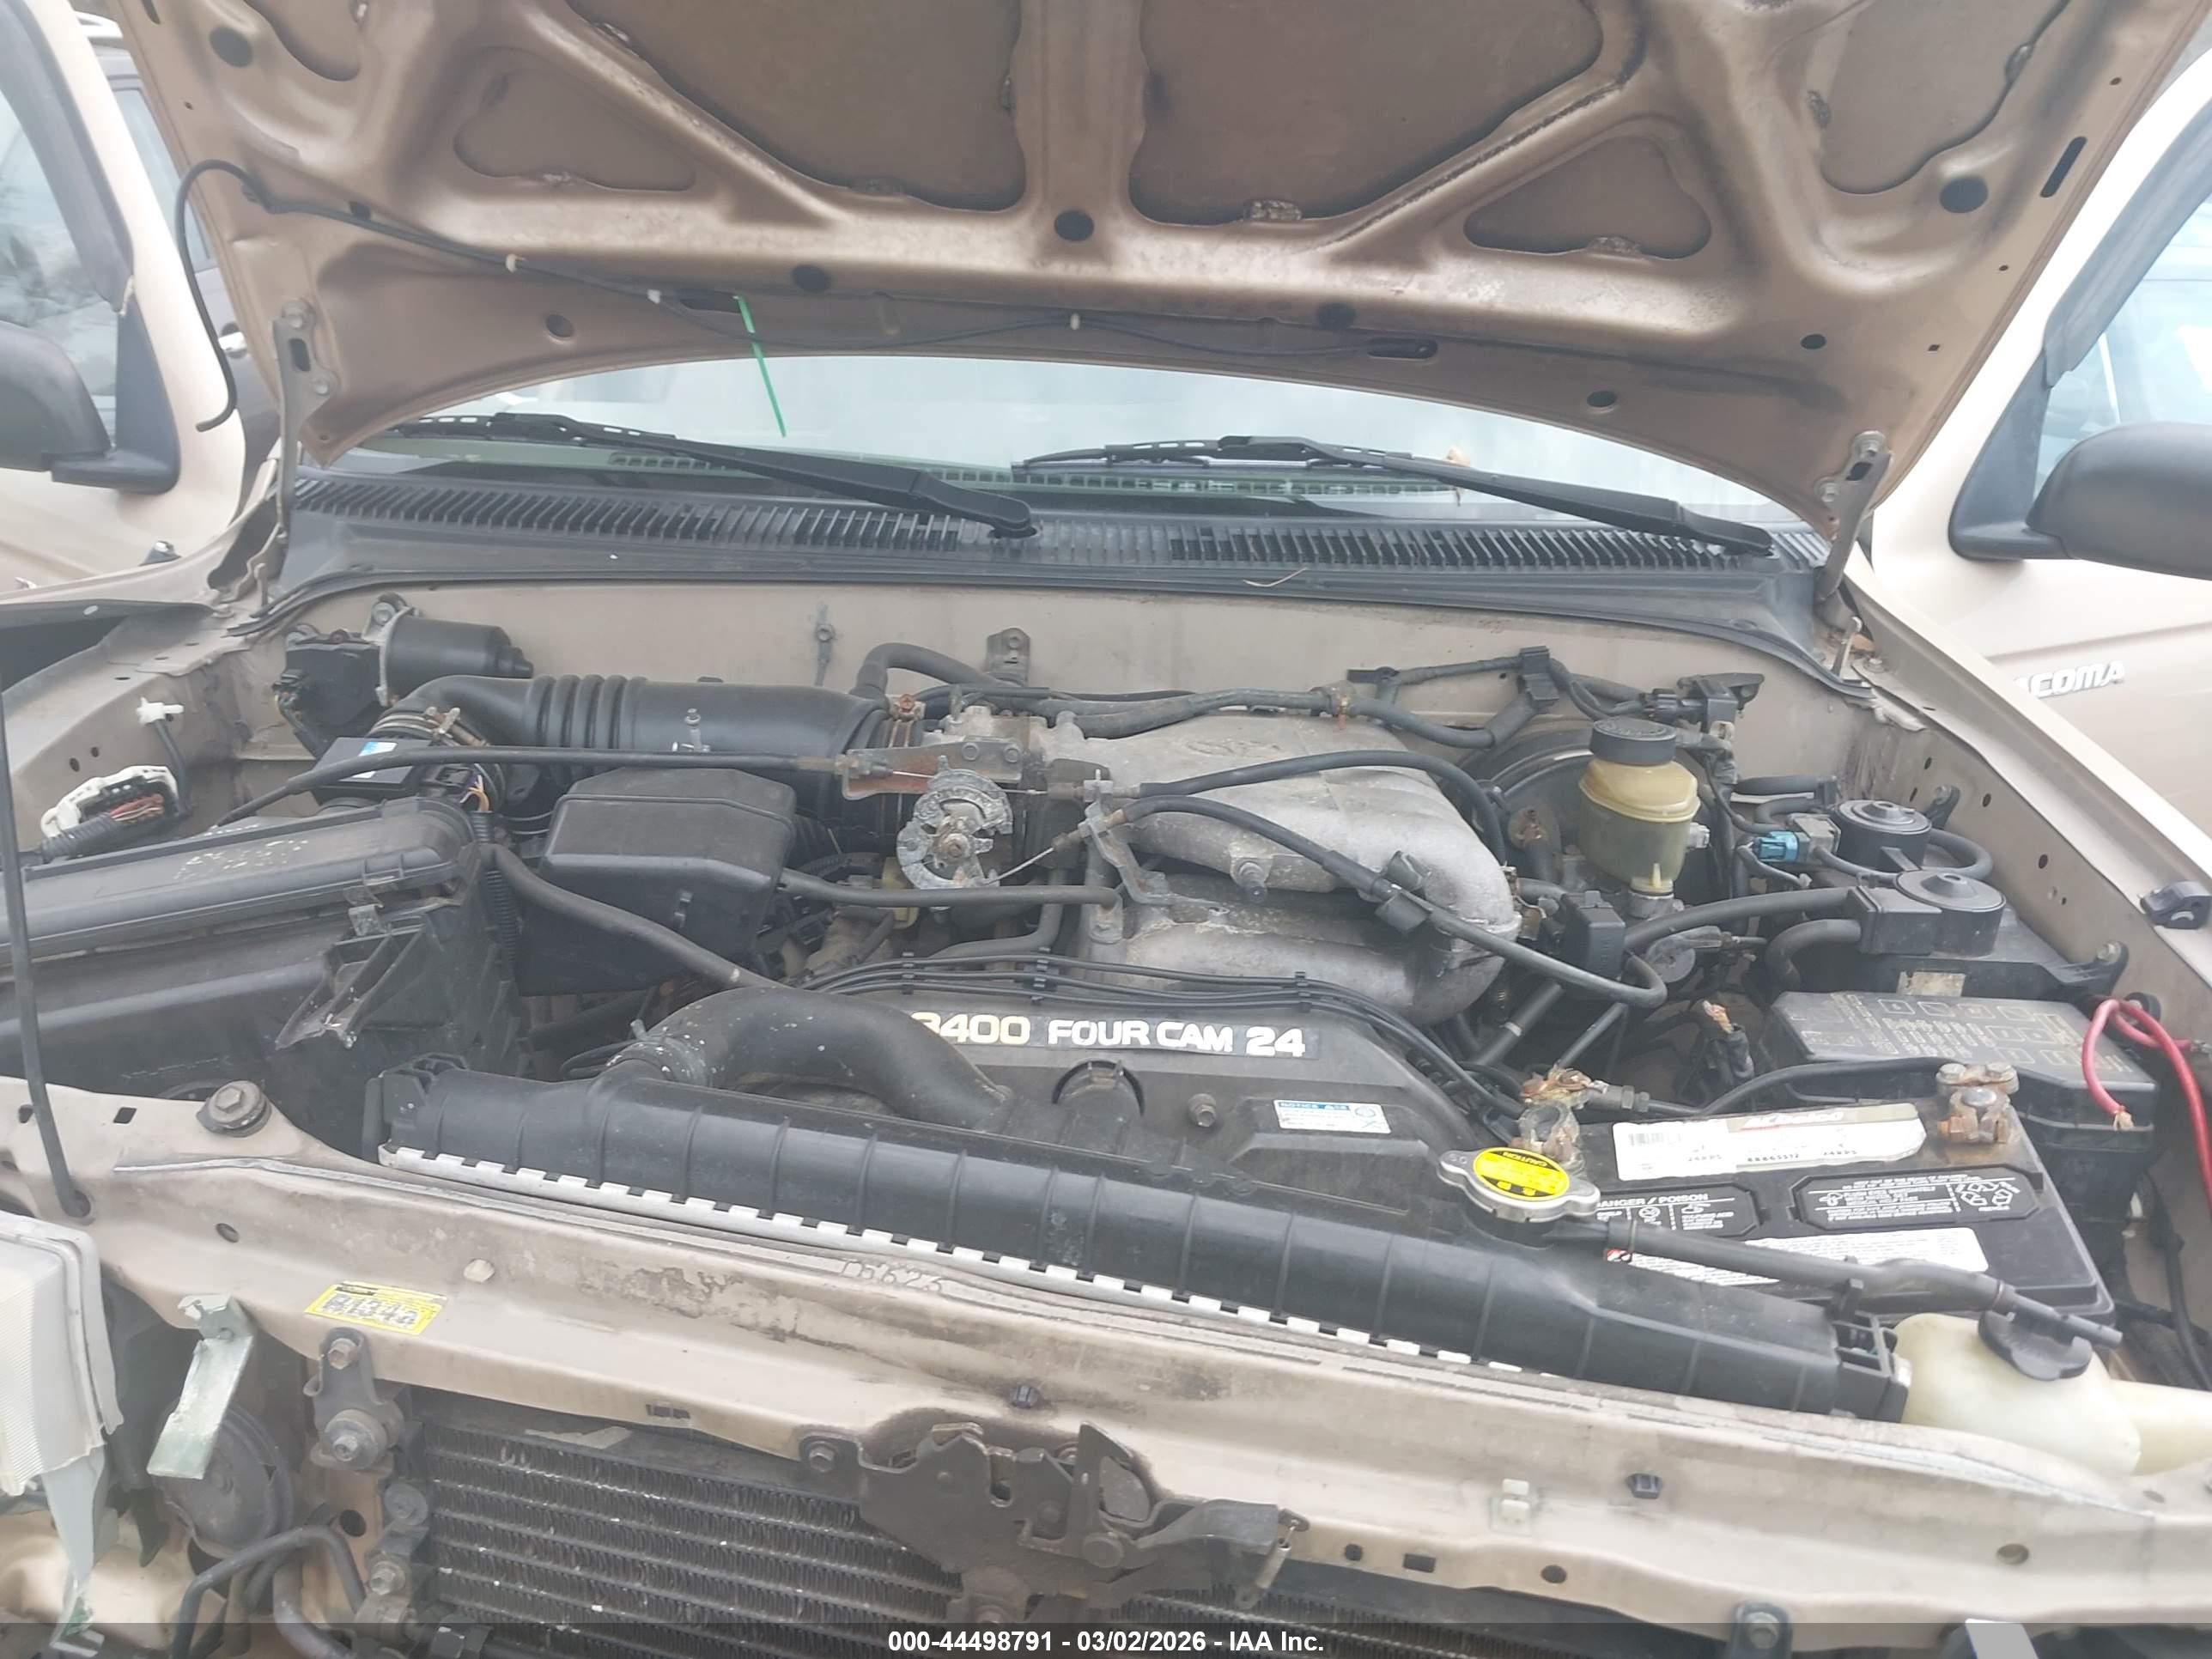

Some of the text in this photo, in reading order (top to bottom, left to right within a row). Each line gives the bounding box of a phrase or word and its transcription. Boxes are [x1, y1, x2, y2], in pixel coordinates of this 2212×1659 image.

[1048, 1019, 1152, 1047] FOUR
[1157, 1021, 1233, 1054] CAM
[1245, 1027, 1306, 1058] 24
[1596, 1198, 1646, 1208] ANGER
[1658, 1193, 1709, 1204] POISON
